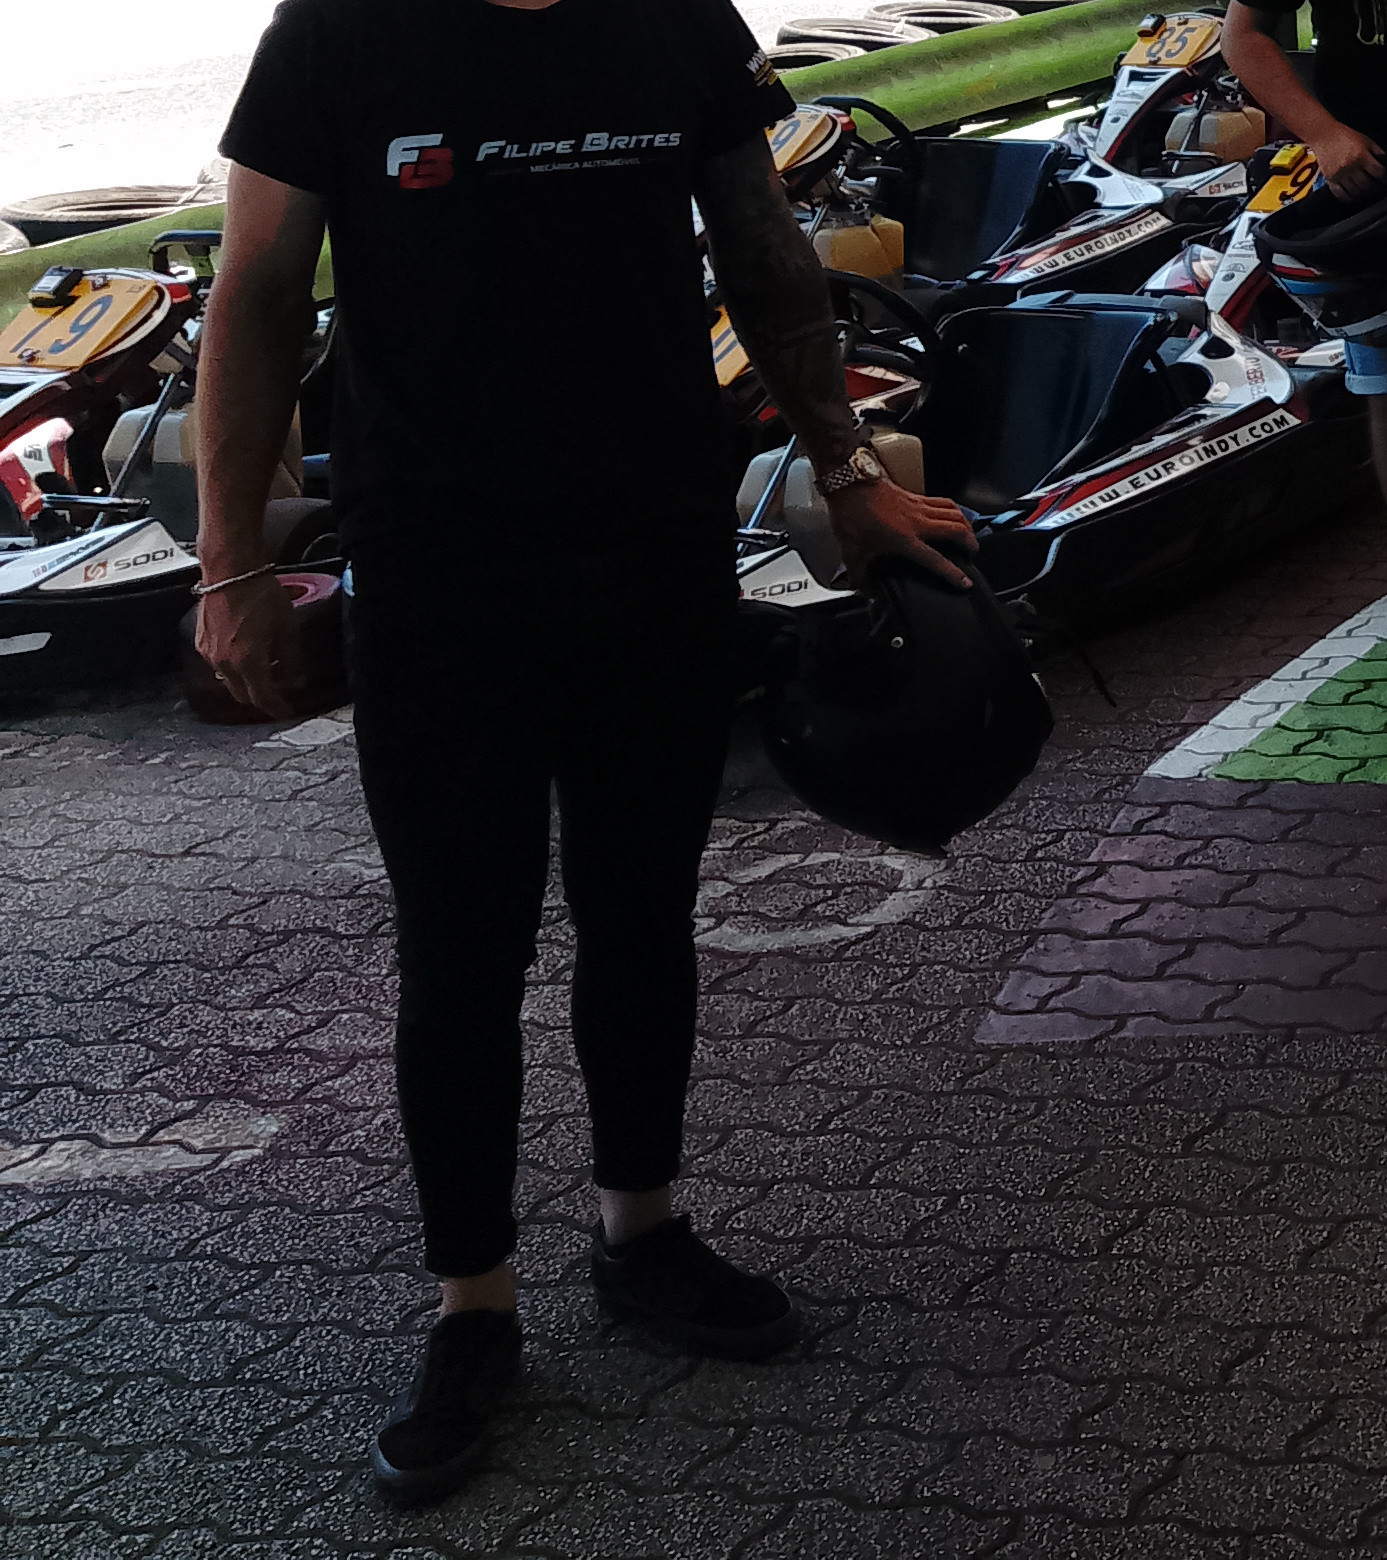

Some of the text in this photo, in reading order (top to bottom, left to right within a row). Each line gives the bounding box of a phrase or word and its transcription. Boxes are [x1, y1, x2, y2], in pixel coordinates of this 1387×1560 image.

[1146, 25, 1199, 59] 85
[474, 131, 683, 163] FILIPE BRITES
